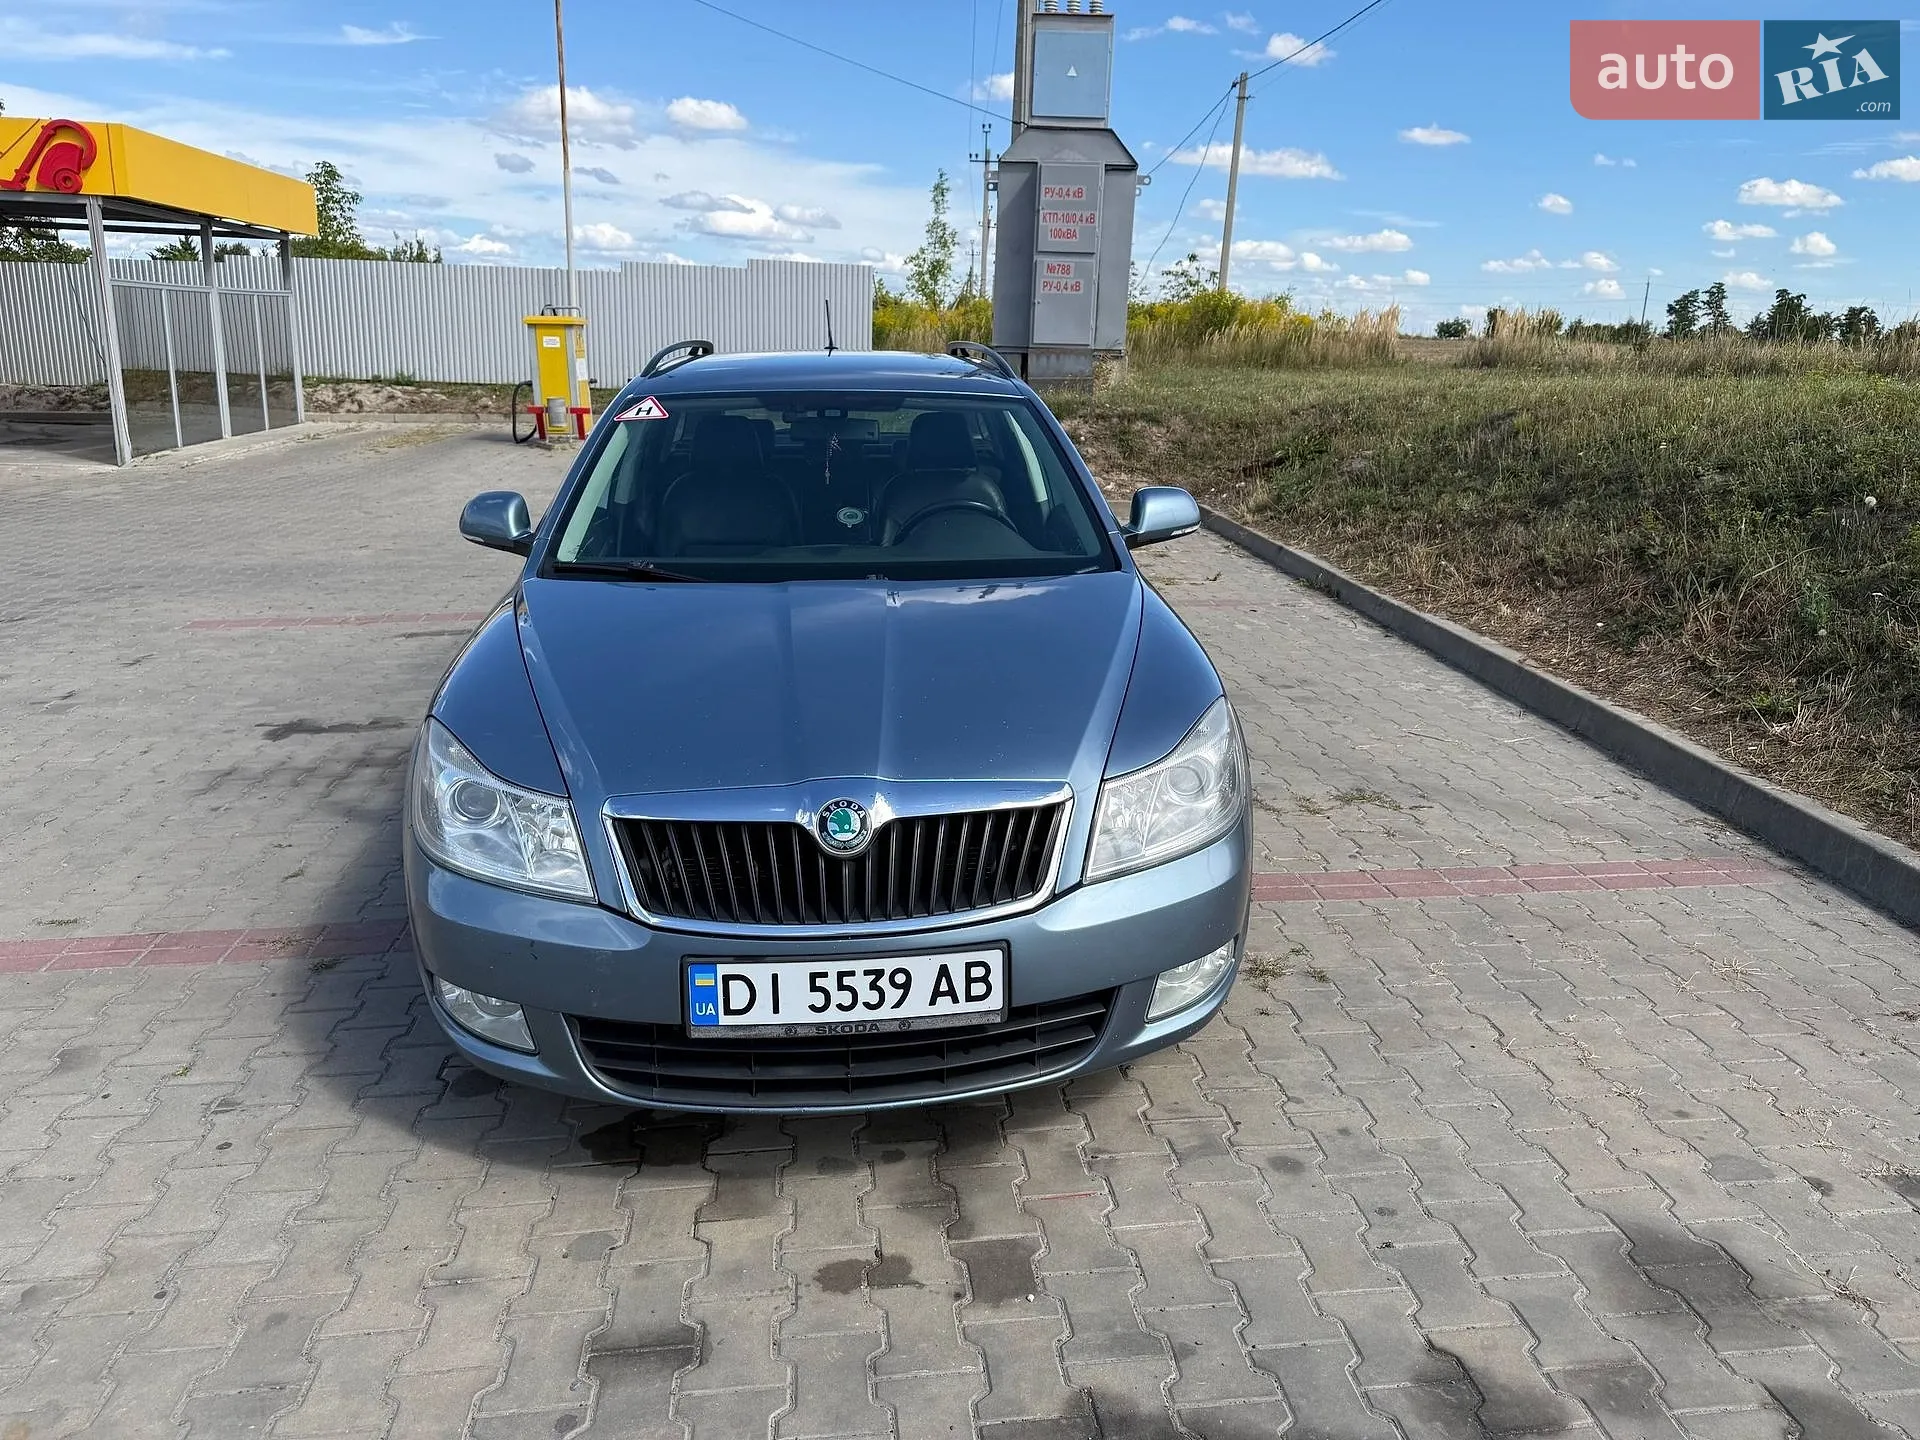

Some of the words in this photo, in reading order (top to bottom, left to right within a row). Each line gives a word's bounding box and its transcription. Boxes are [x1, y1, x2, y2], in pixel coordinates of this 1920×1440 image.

[1046, 263, 1071, 275] №788
[722, 973, 779, 1016] DI
[808, 967, 913, 1014] 5539
[928, 960, 993, 1006] AB
[696, 1003, 716, 1015] UA
[815, 1023, 880, 1035] SKODA
